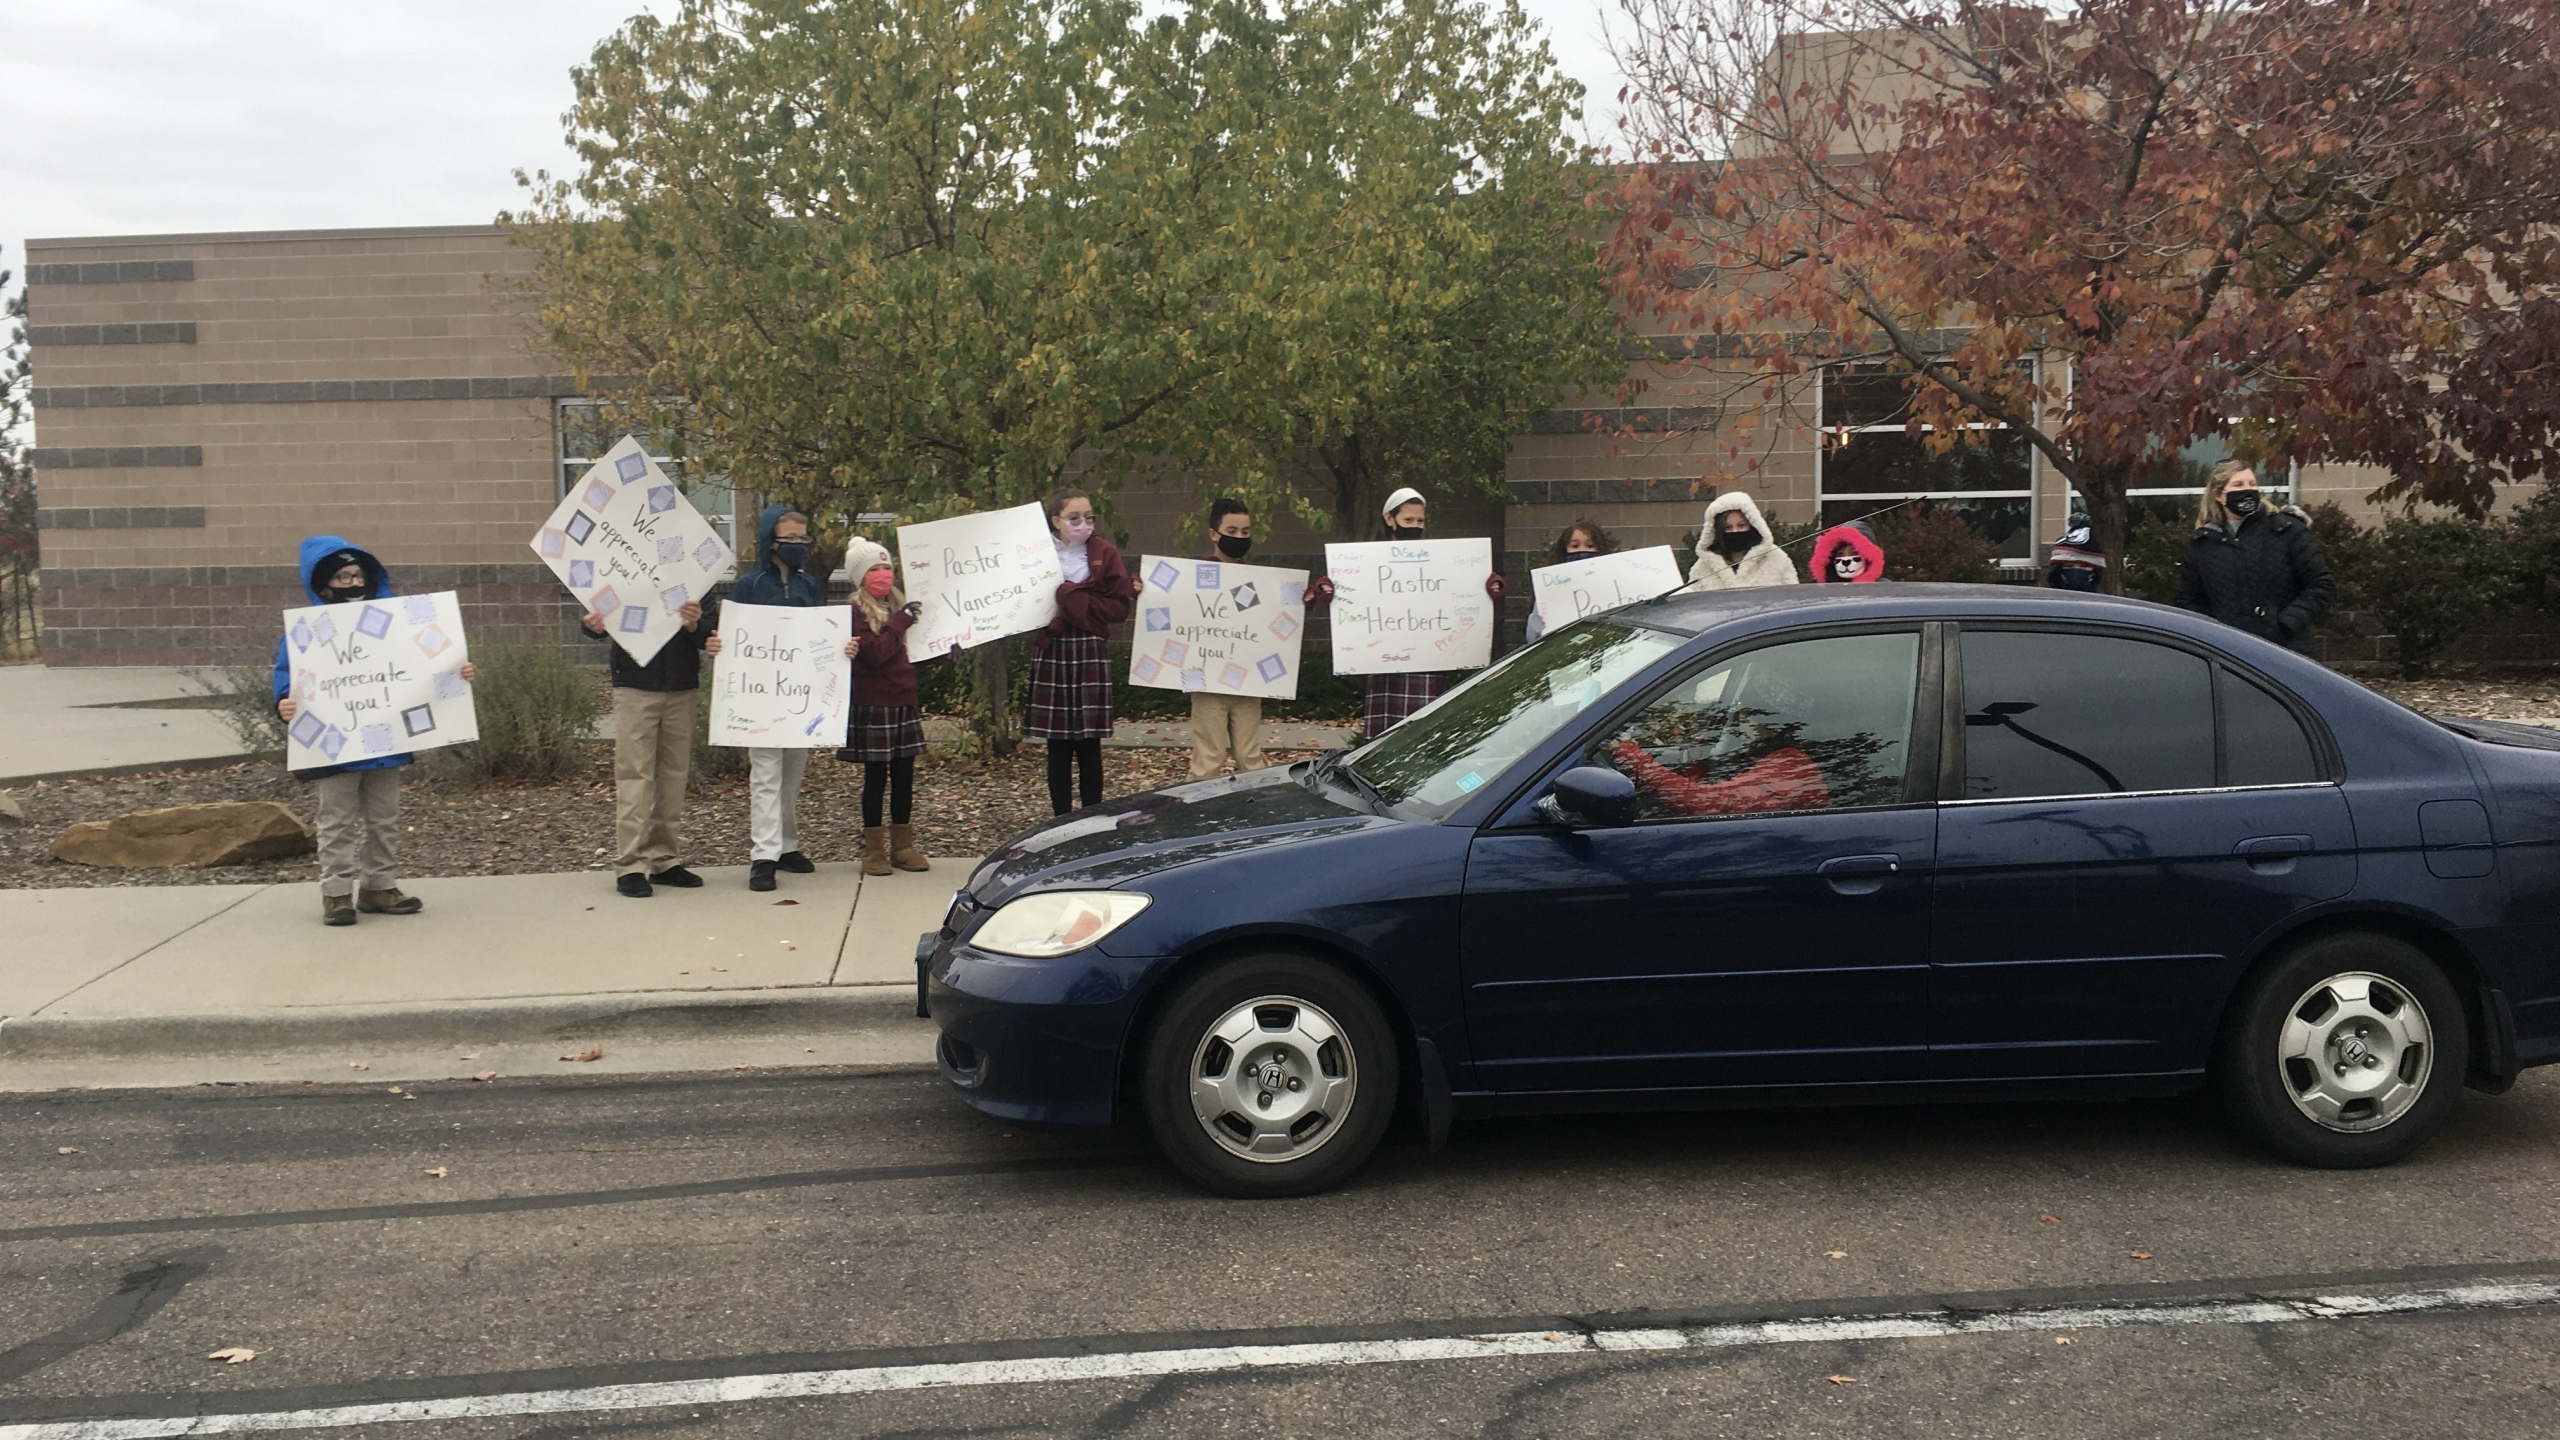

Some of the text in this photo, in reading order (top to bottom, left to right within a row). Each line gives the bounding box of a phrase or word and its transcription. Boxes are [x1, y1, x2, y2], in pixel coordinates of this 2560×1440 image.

[633, 504, 660, 542] We
[600, 521, 661, 588] appreciate
[943, 545, 1004, 578] Pastor
[599, 557, 638, 585] you!
[1378, 565, 1447, 594] Pastor
[941, 585, 1028, 617] Vanessa
[1195, 592, 1230, 619] We
[1175, 625, 1260, 642] appreciate
[1367, 607, 1452, 634] Herbert
[329, 631, 370, 665] We
[734, 628, 803, 663] Pastor
[928, 626, 972, 653] Friend
[1198, 643, 1235, 668] you!
[319, 661, 413, 700] appreciate
[727, 671, 768, 694] Elia
[776, 670, 811, 714] King
[342, 686, 392, 733] you!
